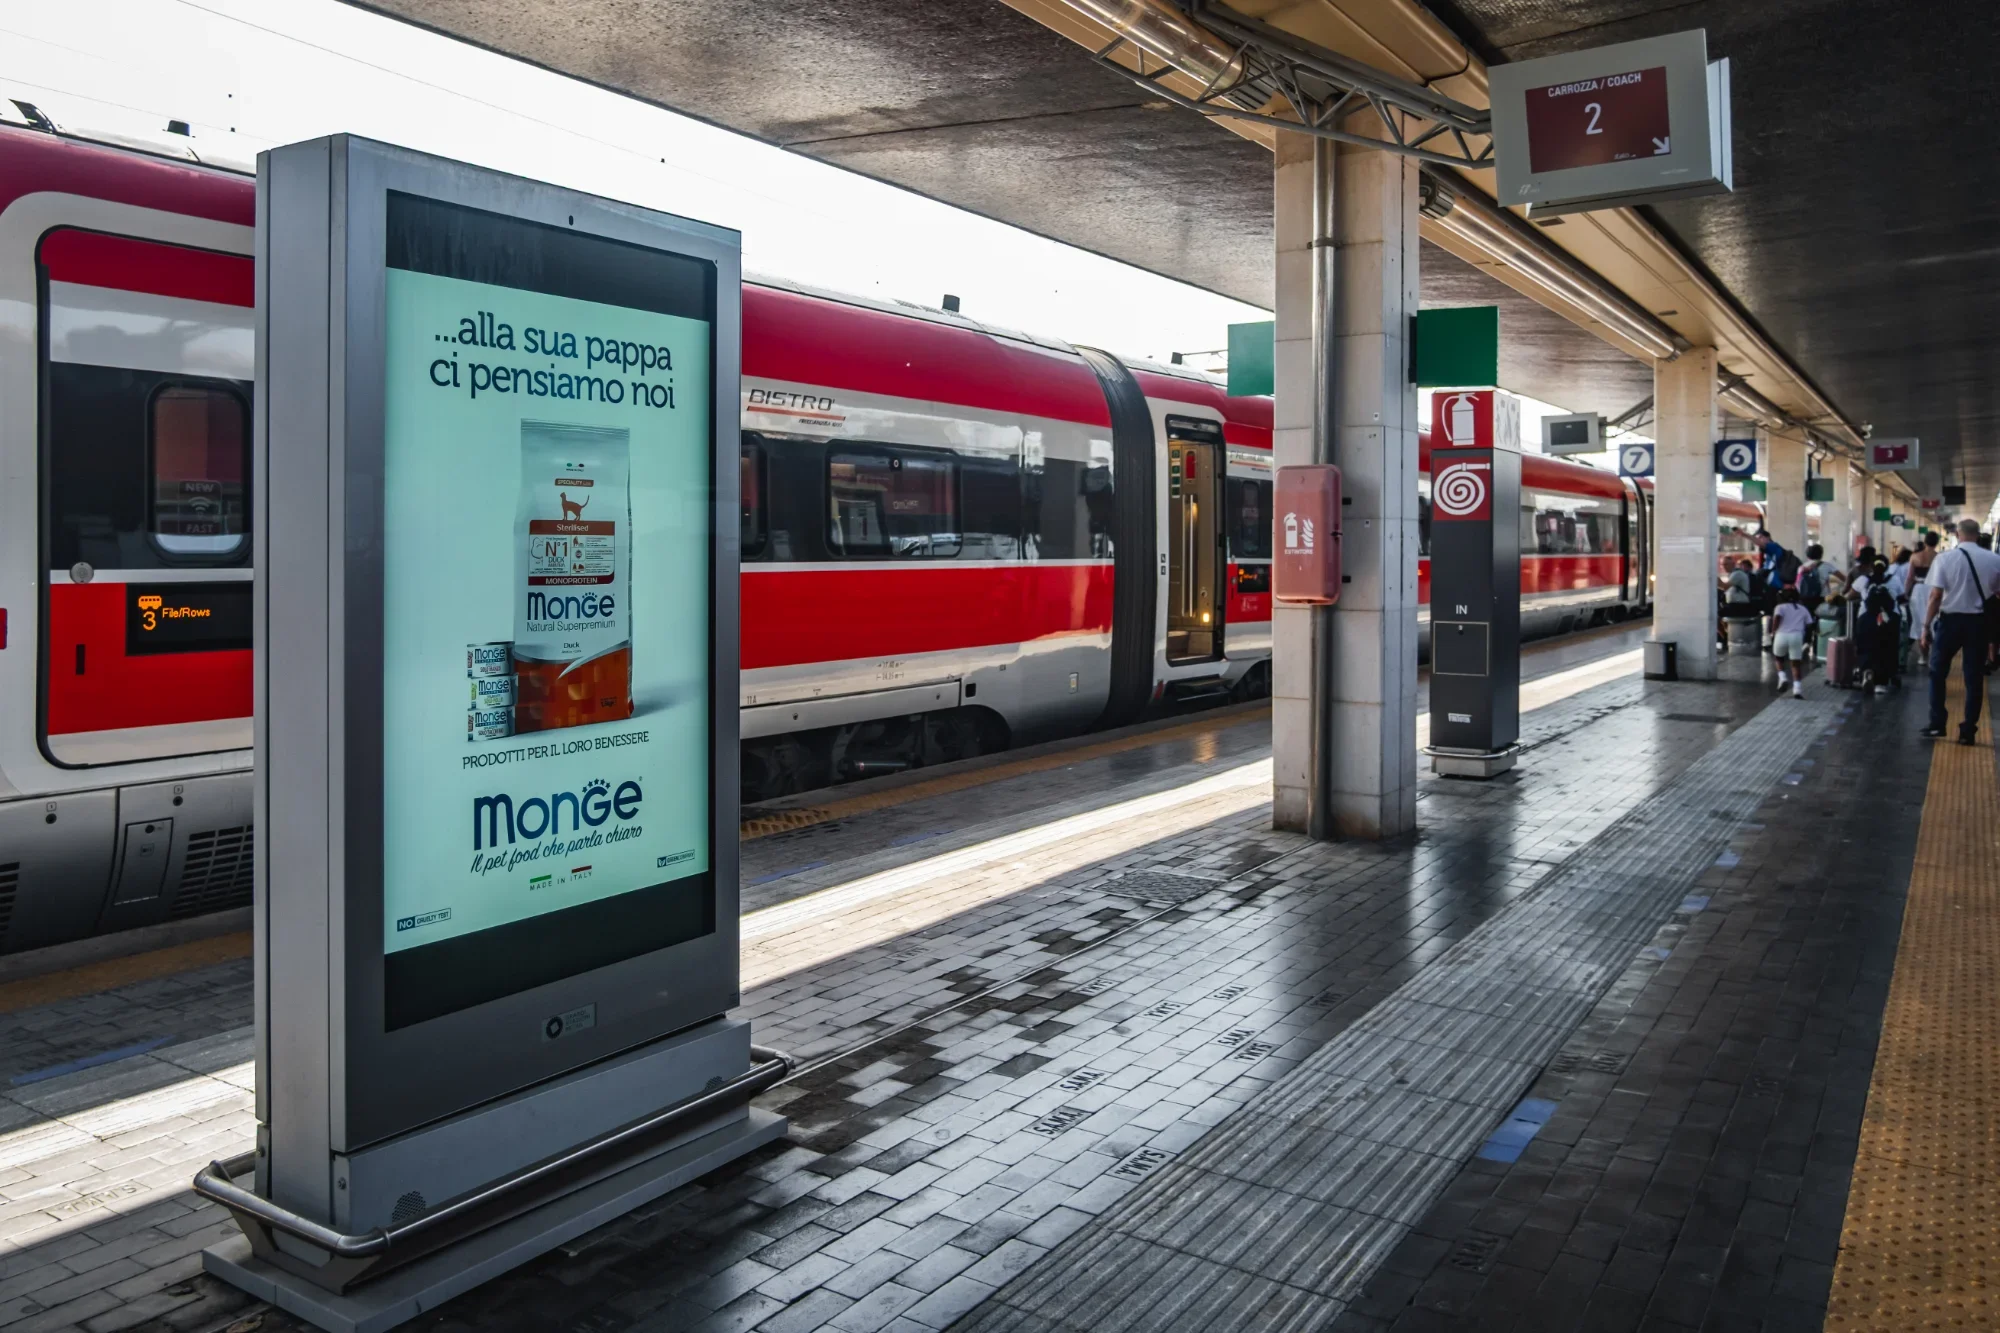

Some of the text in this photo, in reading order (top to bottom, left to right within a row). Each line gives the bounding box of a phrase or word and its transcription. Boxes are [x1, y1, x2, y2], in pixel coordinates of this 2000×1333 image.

[1548, 81, 1599, 97] CARROZZA
[1607, 72, 1642, 88] COACH
[1584, 102, 1603, 136] 2
[435, 311, 673, 375] ...alla sua pappa
[430, 352, 675, 409] ci pensiamo noi
[1628, 451, 1644, 469] 7
[1729, 449, 1745, 467] 6
[185, 483, 214, 492] NEW
[186, 524, 213, 534] FAST
[556, 524, 589, 532] Sterilised
[545, 577, 598, 585] MONOPROTEIN
[162, 607, 210, 618] File/Rows
[1455, 604, 1468, 615] IN
[142, 611, 156, 630] 3
[527, 620, 615, 632] Natural Superpremium
[462, 731, 650, 769] PRODOTTI PER IL LORO BENESSERE
[470, 824, 643, 876] Il pet food che parla chiaro
[529, 871, 593, 891] MADE IN ITALY
[398, 911, 449, 930] NO CRUELTY TEST
